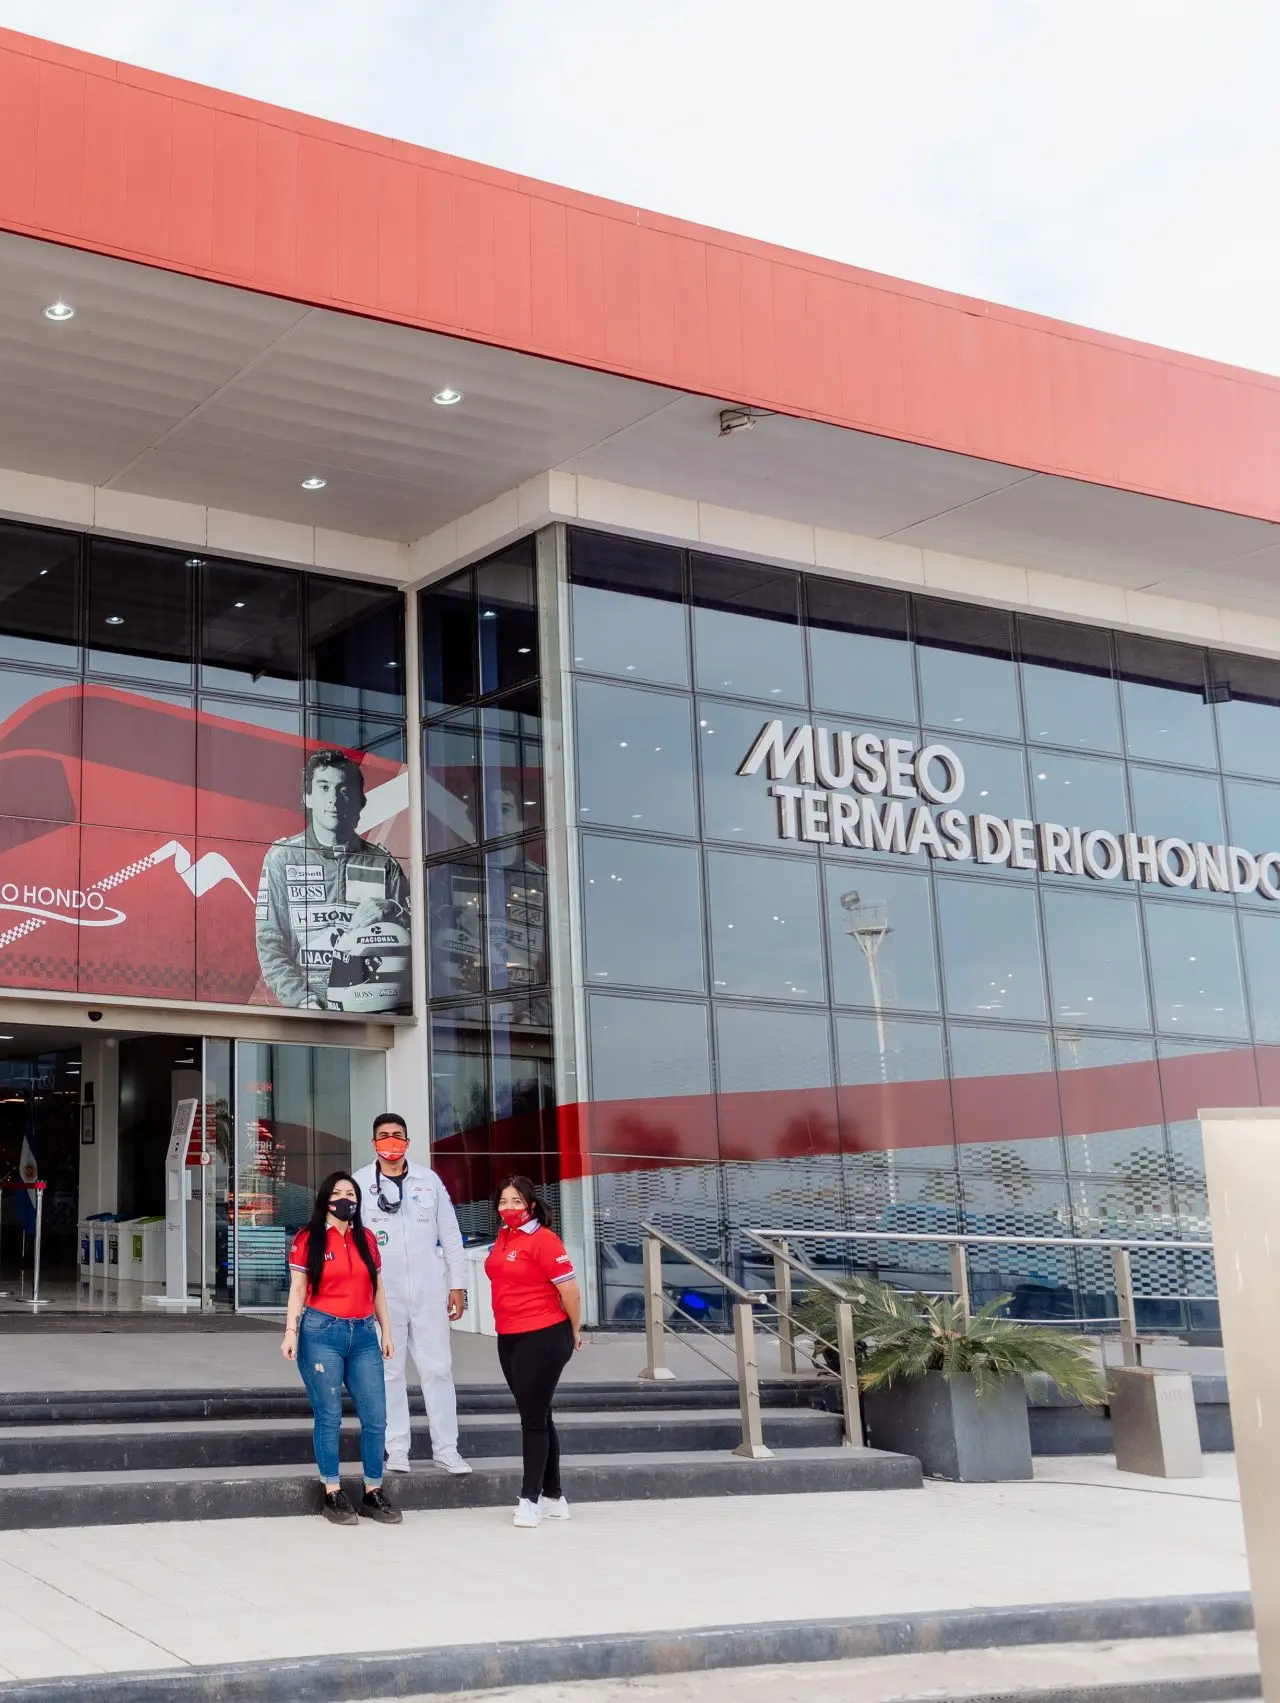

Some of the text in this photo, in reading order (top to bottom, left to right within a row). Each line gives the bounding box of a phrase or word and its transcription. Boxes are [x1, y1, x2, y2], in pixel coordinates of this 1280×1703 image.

[737, 719, 965, 804] MUSEO
[769, 784, 972, 861] TERMAS
[973, 812, 1037, 870] DE
[1037, 822, 1123, 881] RIO
[23, 884, 104, 911] HONDO
[290, 886, 323, 898] BOSS
[312, 910, 353, 923] HON
[360, 936, 395, 944] NACIONAL
